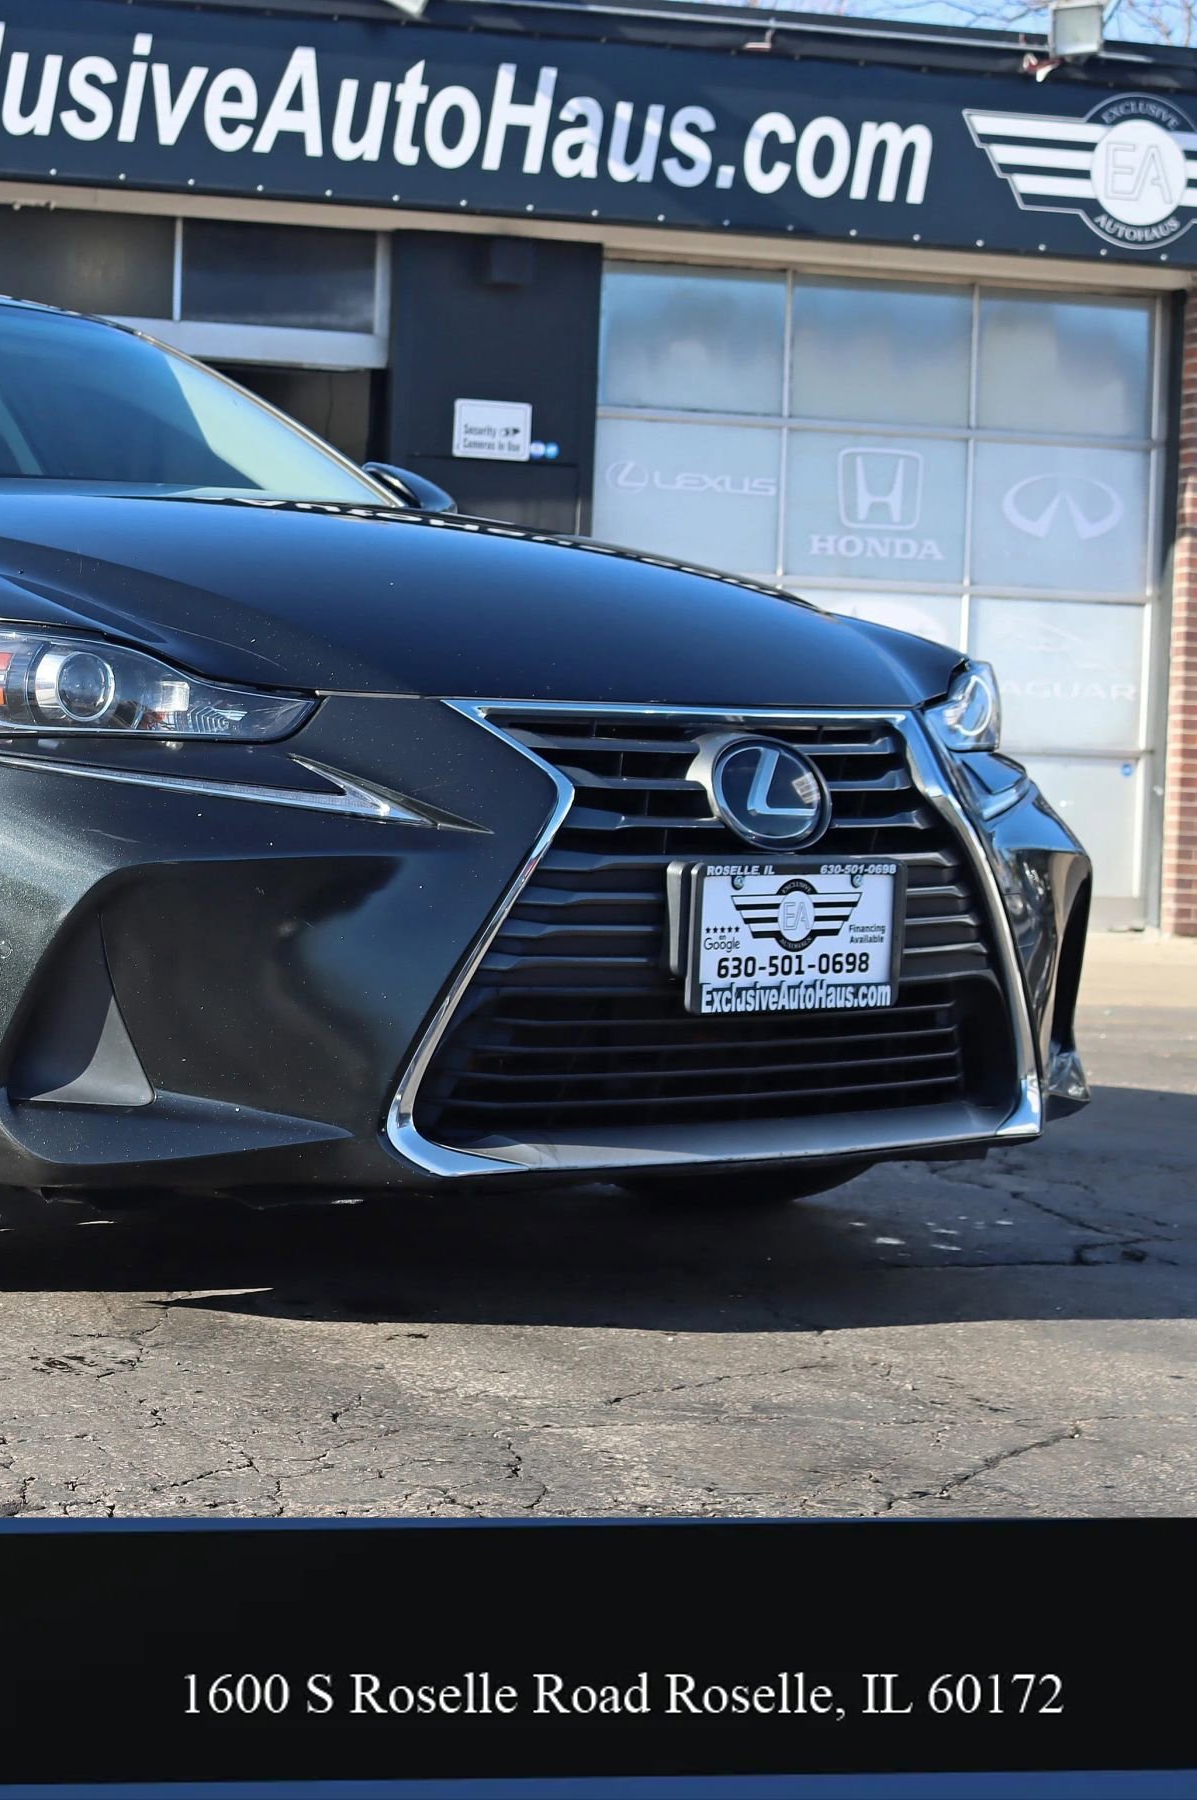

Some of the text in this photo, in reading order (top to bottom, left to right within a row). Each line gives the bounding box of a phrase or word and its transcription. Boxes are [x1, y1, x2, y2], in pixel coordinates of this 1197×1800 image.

[1101, 100, 1180, 130] EXCLUSIVE
[1105, 142, 1173, 205] EA
[1094, 213, 1181, 242] AUTOHAUS
[463, 424, 497, 438] Security
[653, 472, 777, 496] LEXUS
[809, 534, 946, 562] HONDA
[1002, 679, 1139, 700] AGUAR
[763, 865, 775, 875] IL
[820, 864, 897, 875] 630-501-0698
[783, 902, 810, 930] EA
[849, 924, 885, 935] Financing
[850, 936, 884, 944] Available
[704, 936, 740, 953] Google
[717, 952, 870, 978] 630-501-0698
[701, 979, 892, 1013] ExclusiveAutoHaus.com
